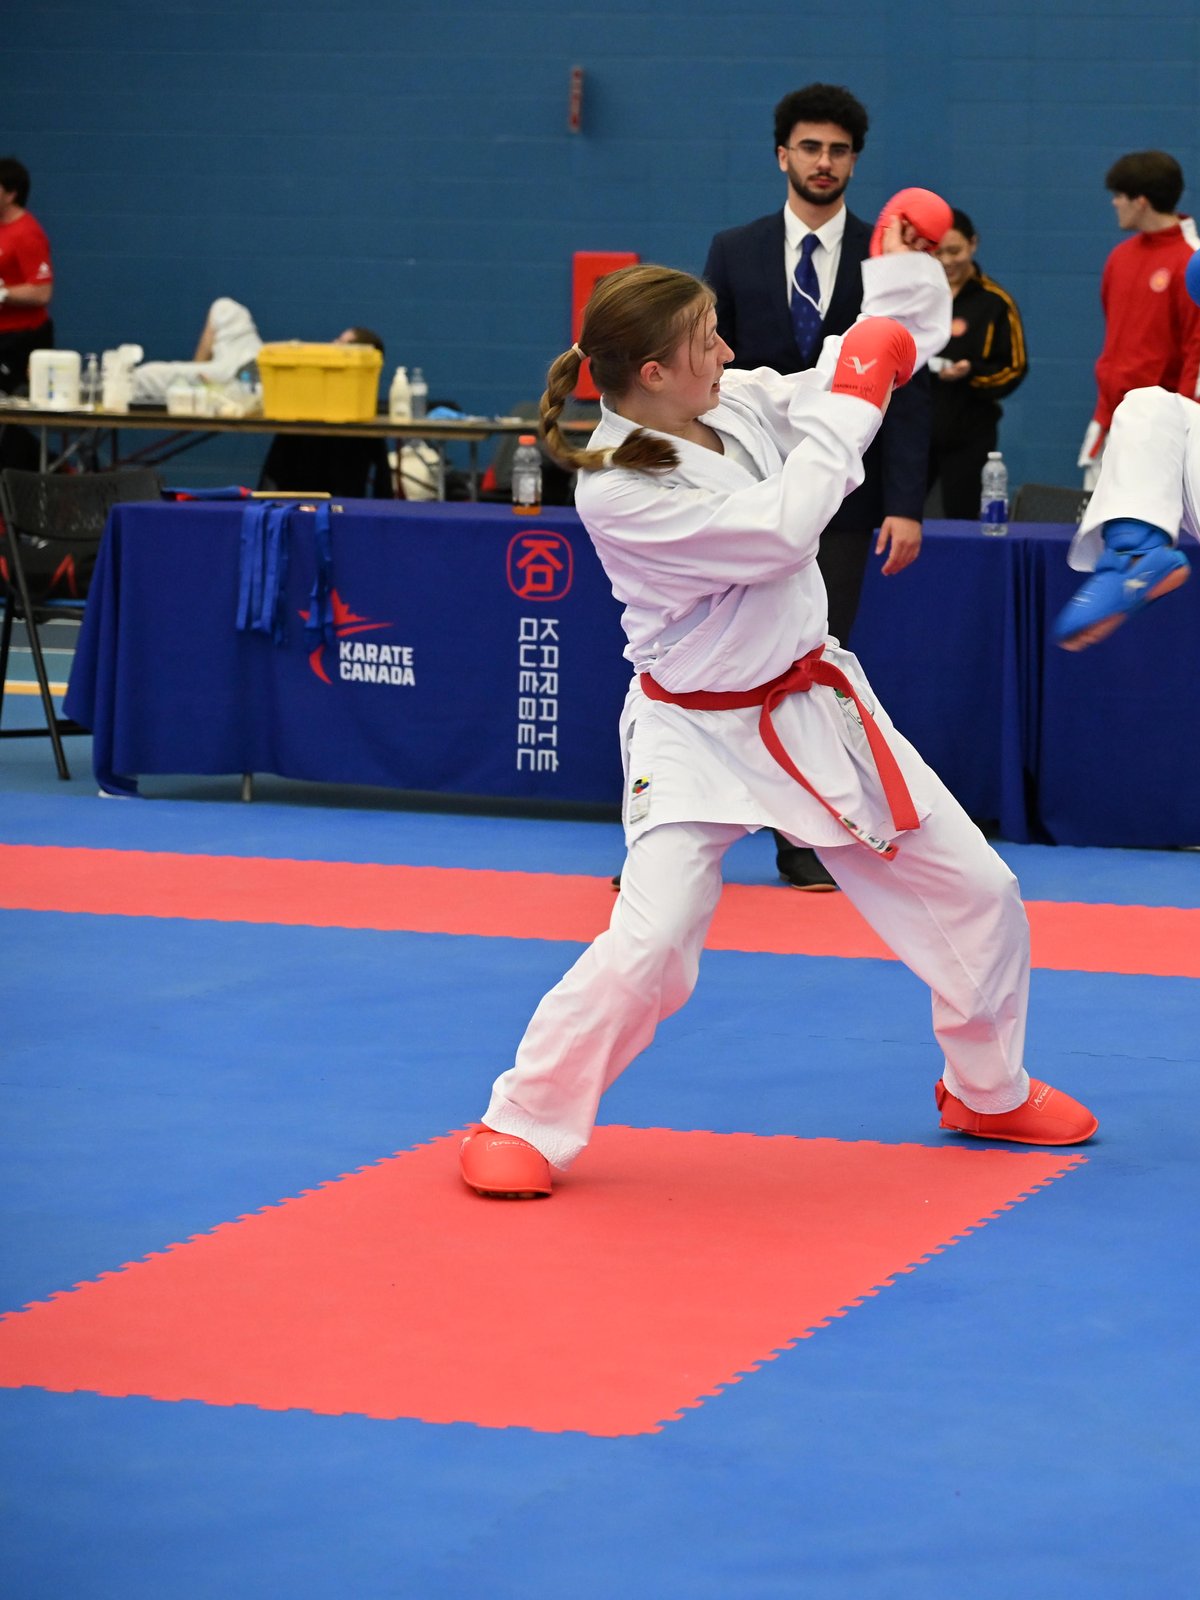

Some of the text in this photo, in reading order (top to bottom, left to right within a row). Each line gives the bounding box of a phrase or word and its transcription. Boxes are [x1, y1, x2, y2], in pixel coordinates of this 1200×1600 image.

[340, 641, 414, 666] KARATE
[340, 661, 416, 687] CANADA
[517, 617, 539, 771] QUÉBEC
